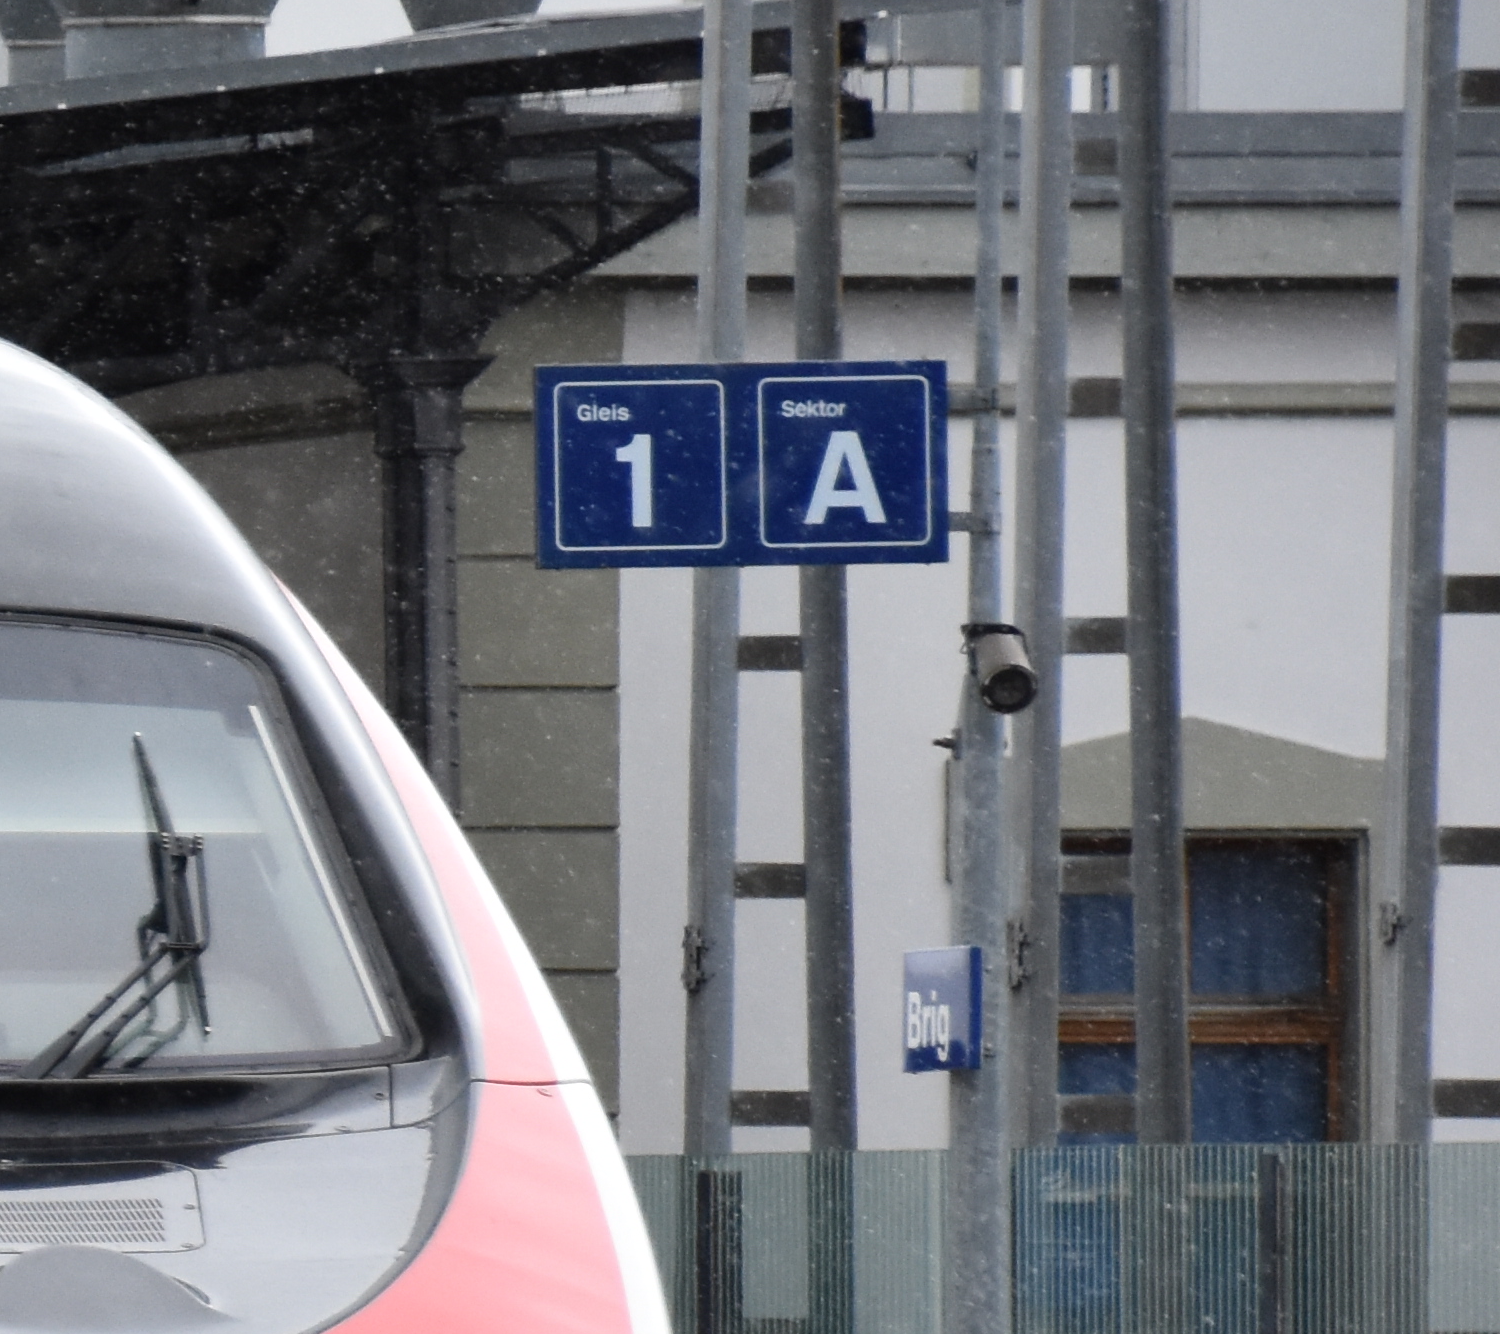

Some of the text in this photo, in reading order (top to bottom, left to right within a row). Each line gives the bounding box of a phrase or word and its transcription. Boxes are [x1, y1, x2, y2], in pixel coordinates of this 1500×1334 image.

[577, 404, 630, 422] Gleis
[781, 400, 847, 417] Sektor
[616, 433, 653, 528] 1
[804, 430, 887, 525] A
[907, 990, 950, 1061] Brig
